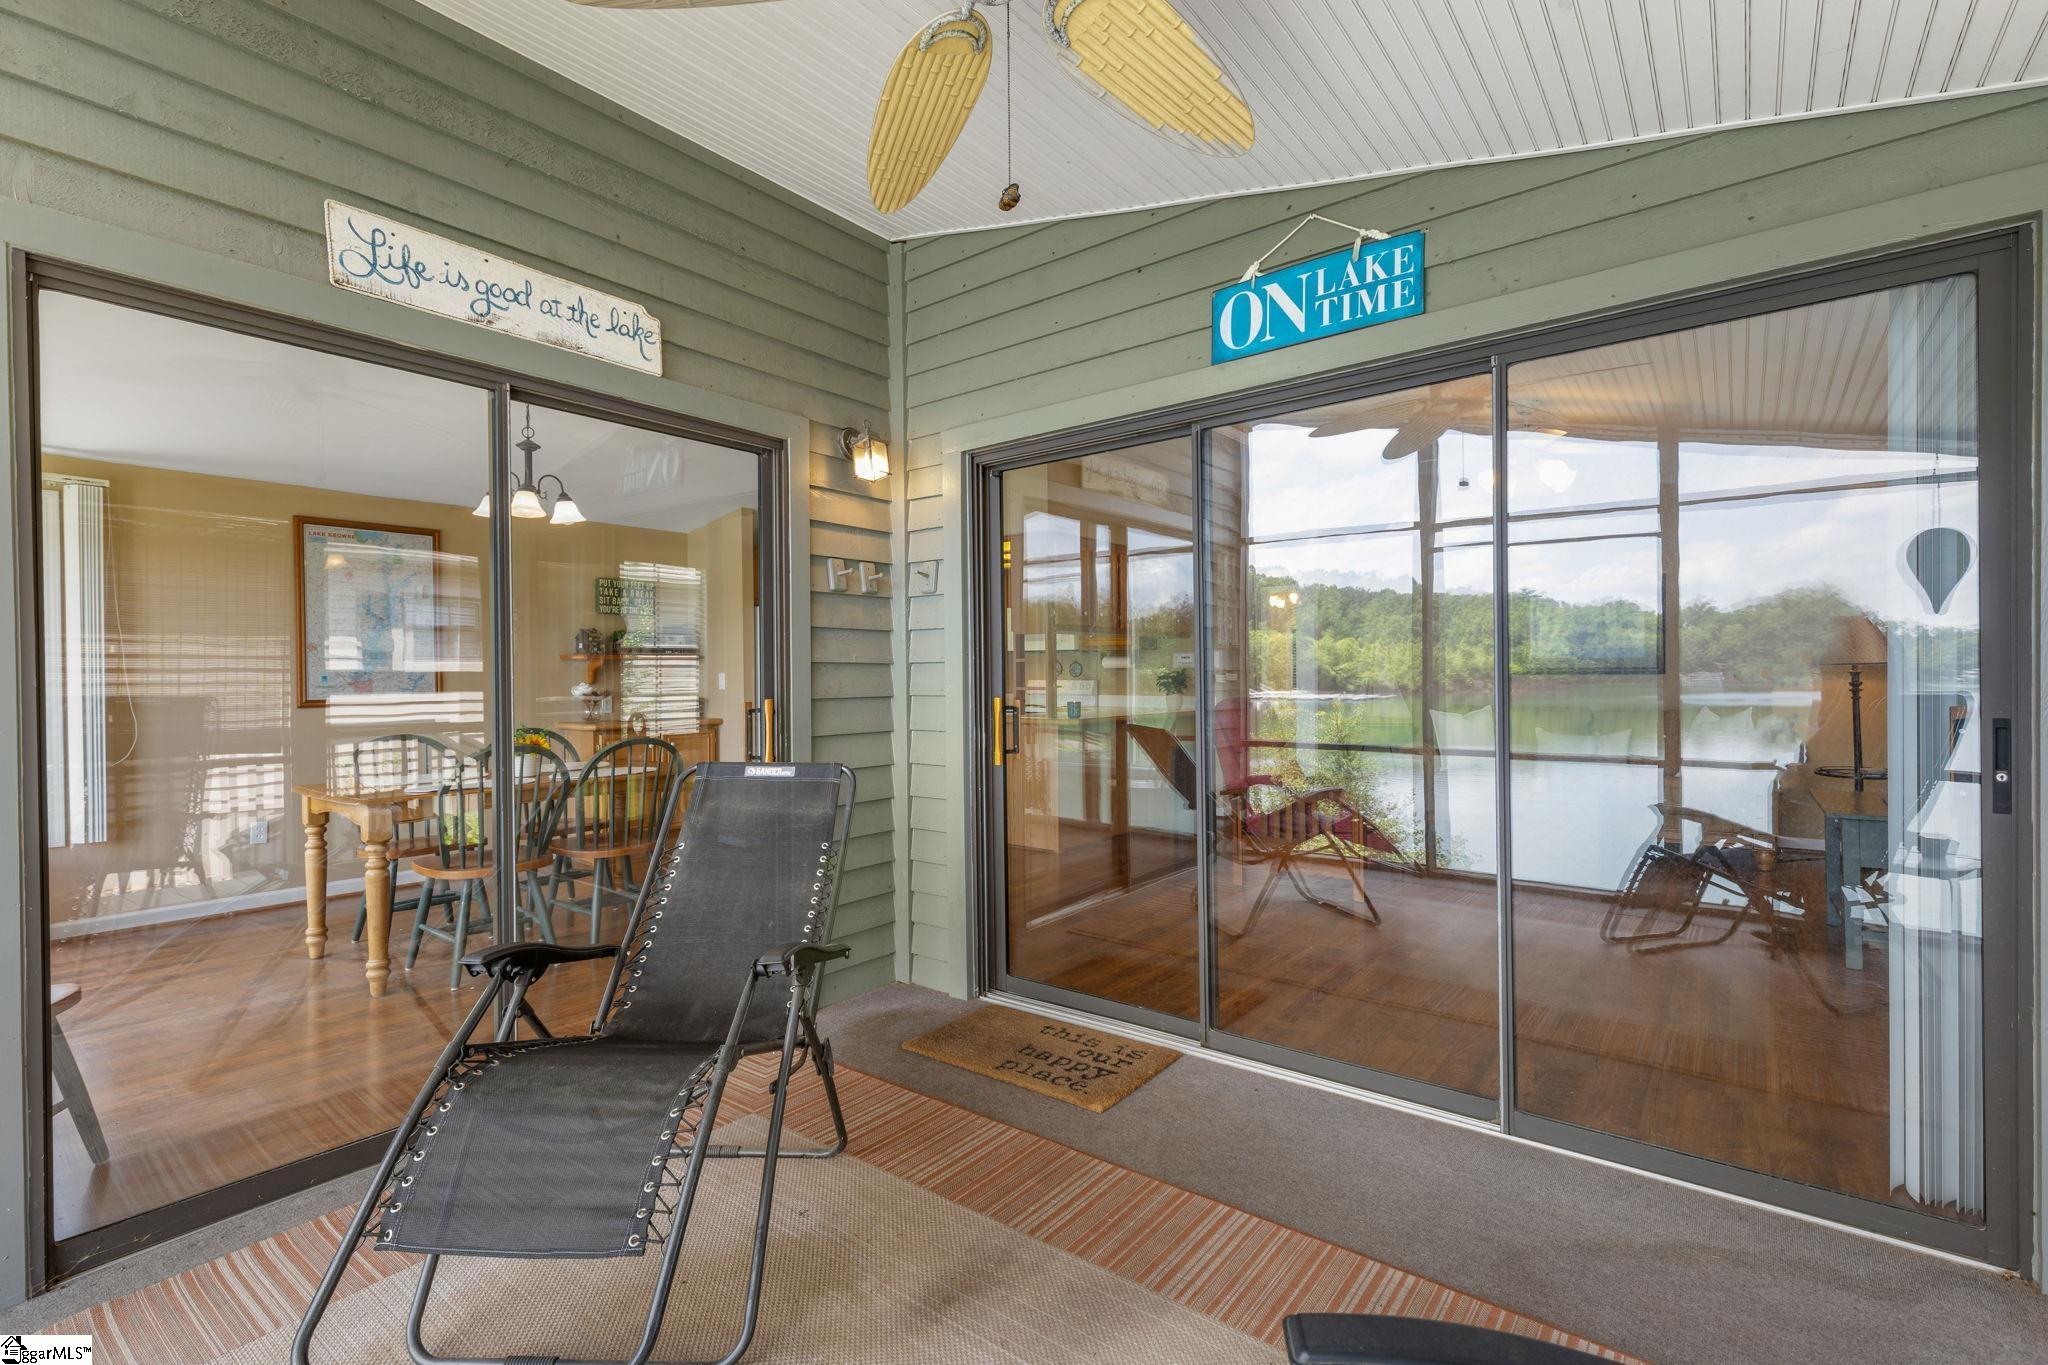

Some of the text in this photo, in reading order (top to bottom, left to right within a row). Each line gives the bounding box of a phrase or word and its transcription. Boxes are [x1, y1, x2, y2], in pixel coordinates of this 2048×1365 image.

[1315, 244, 1415, 297] LAKE
[339, 216, 657, 362] Life is good at the lake
[1314, 277, 1416, 327] TIME
[1220, 271, 1312, 350] ON
[599, 579, 611, 587] PUT
[613, 580, 629, 588] YOUR
[630, 581, 644, 590] FEET
[599, 587, 619, 596] TAKE
[630, 590, 654, 598] BREAK
[599, 596, 610, 605] SIT
[599, 605, 620, 613] YOU'RE
[1040, 1024, 1148, 1060] this is
[1076, 1049, 1133, 1067] our
[1018, 1043, 1120, 1080] happy
